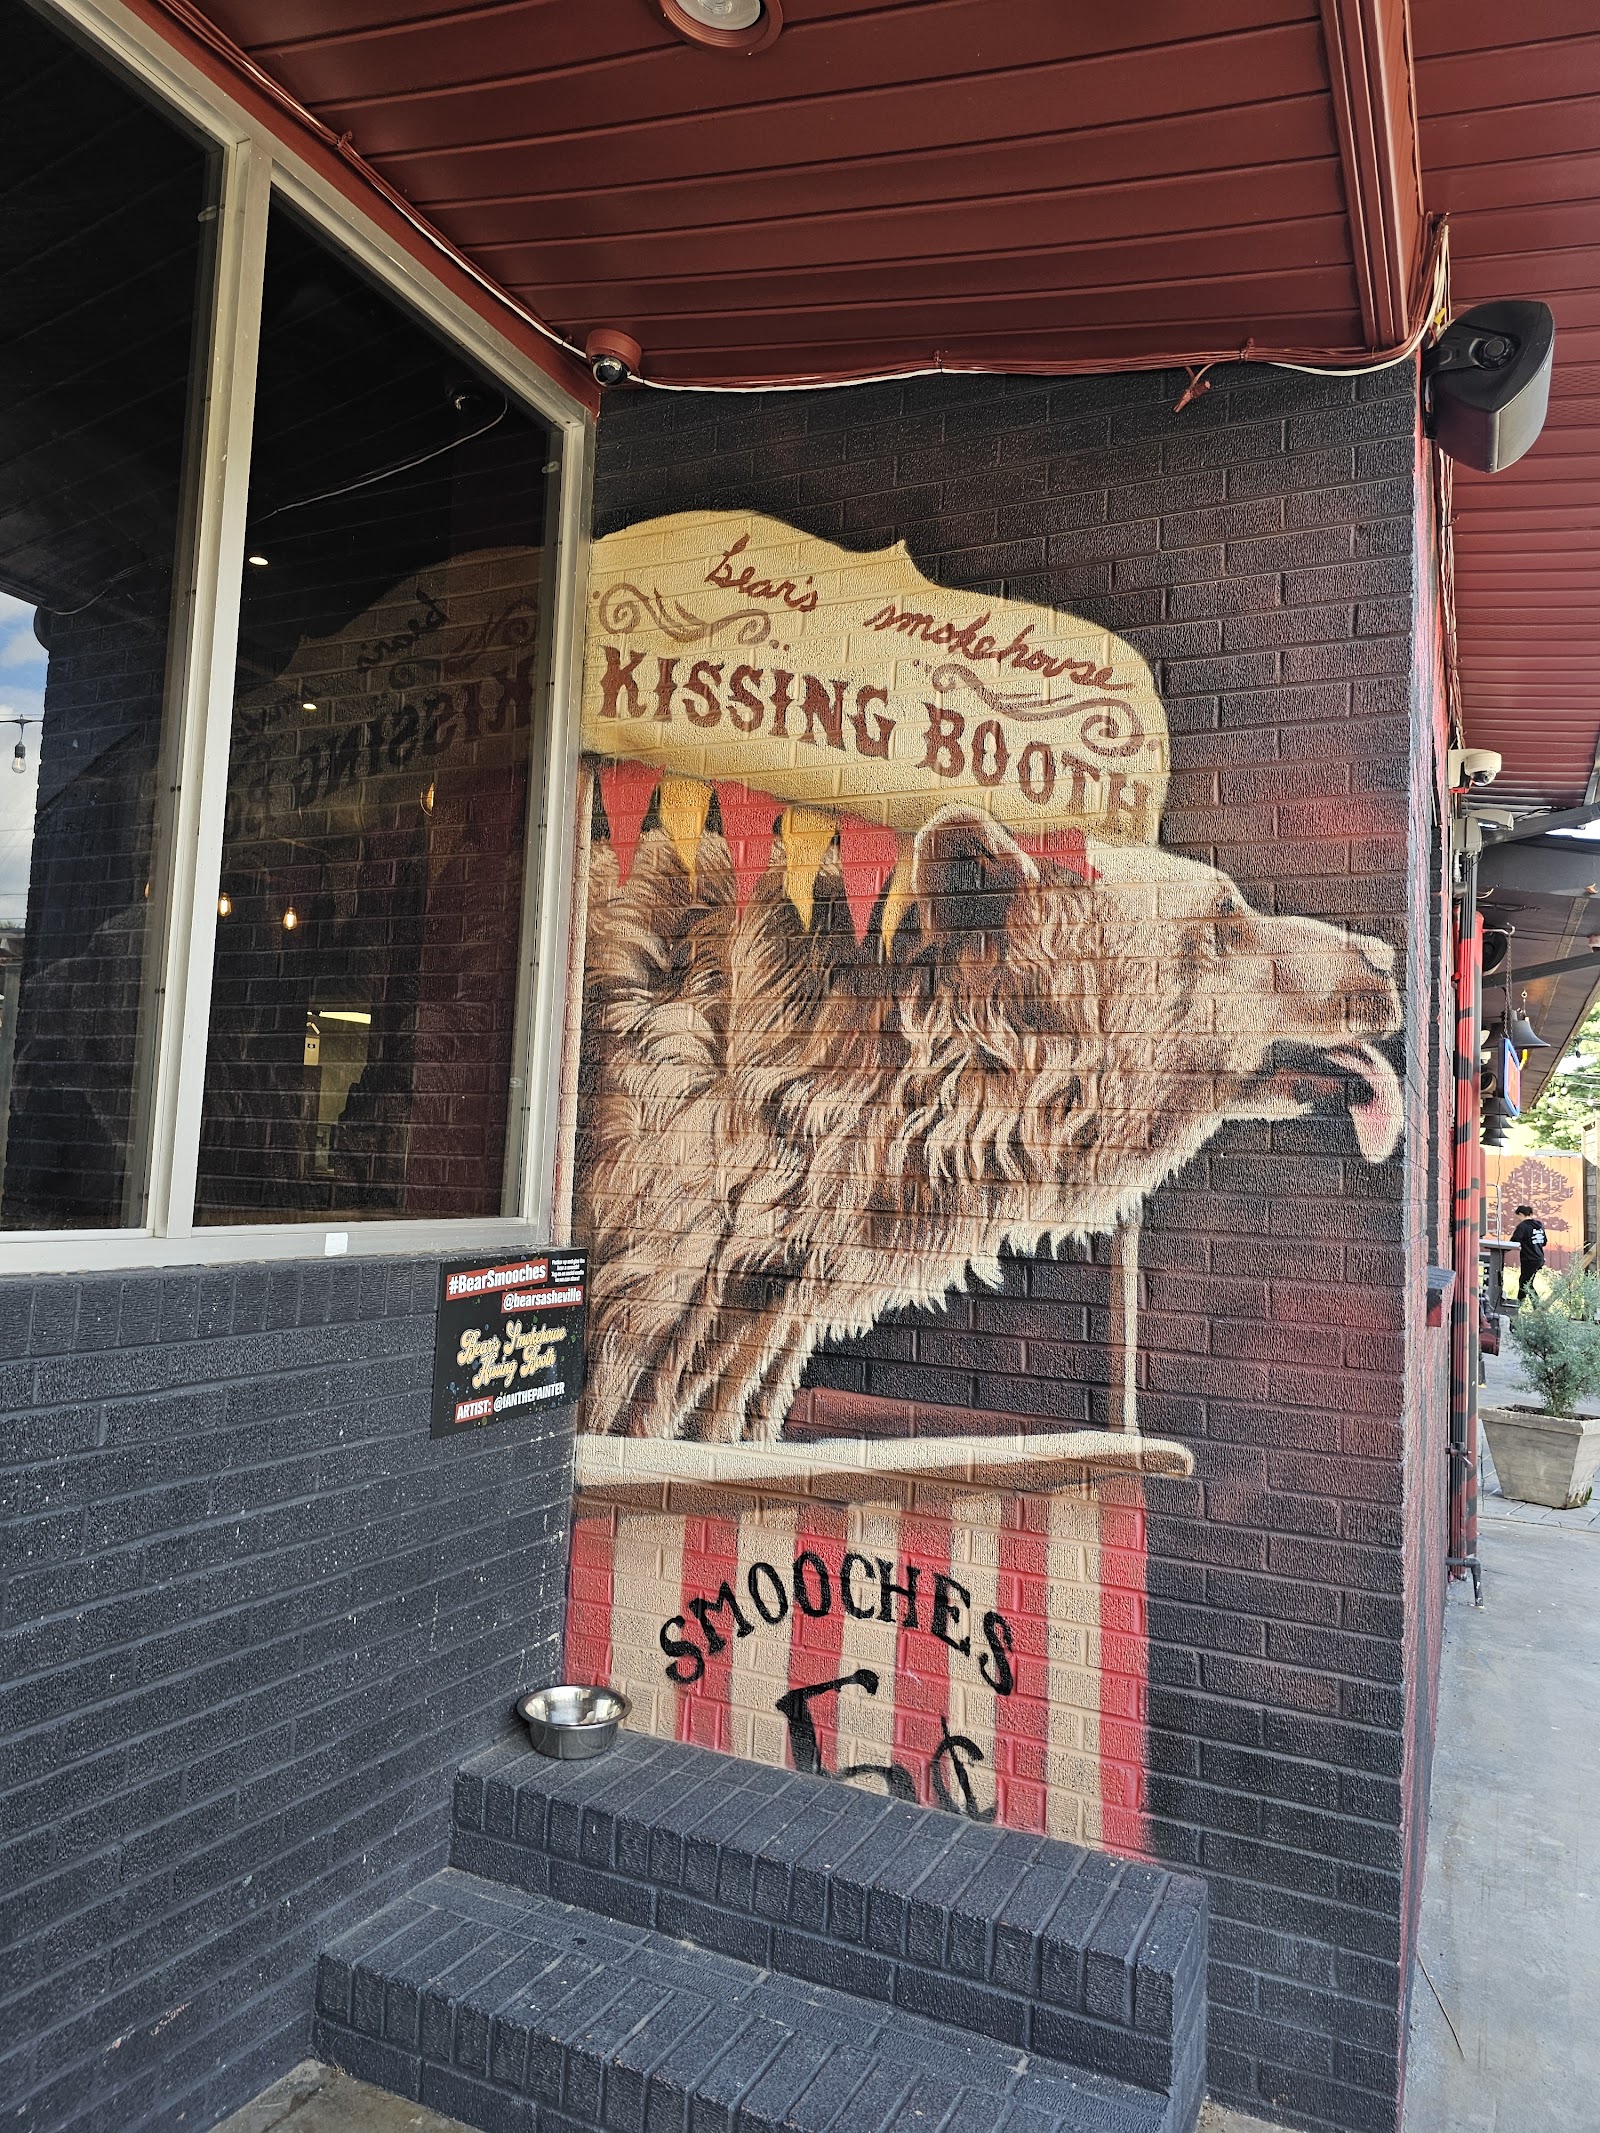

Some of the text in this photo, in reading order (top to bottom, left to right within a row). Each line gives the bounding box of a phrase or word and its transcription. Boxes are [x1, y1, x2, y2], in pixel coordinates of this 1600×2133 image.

[863, 603, 1133, 692] smokehouse
[599, 644, 1150, 830] KISSING BOOTH
[449, 1263, 547, 1295] #BearSmooches
[503, 1287, 582, 1311] @bearsasheville
[503, 1319, 568, 1356] Smokehouse
[519, 1344, 557, 1378] Booth
[456, 1381, 565, 1420] ARTIST: @IANTHEPAINTER
[659, 1550, 1014, 1697] SMOOCHES
